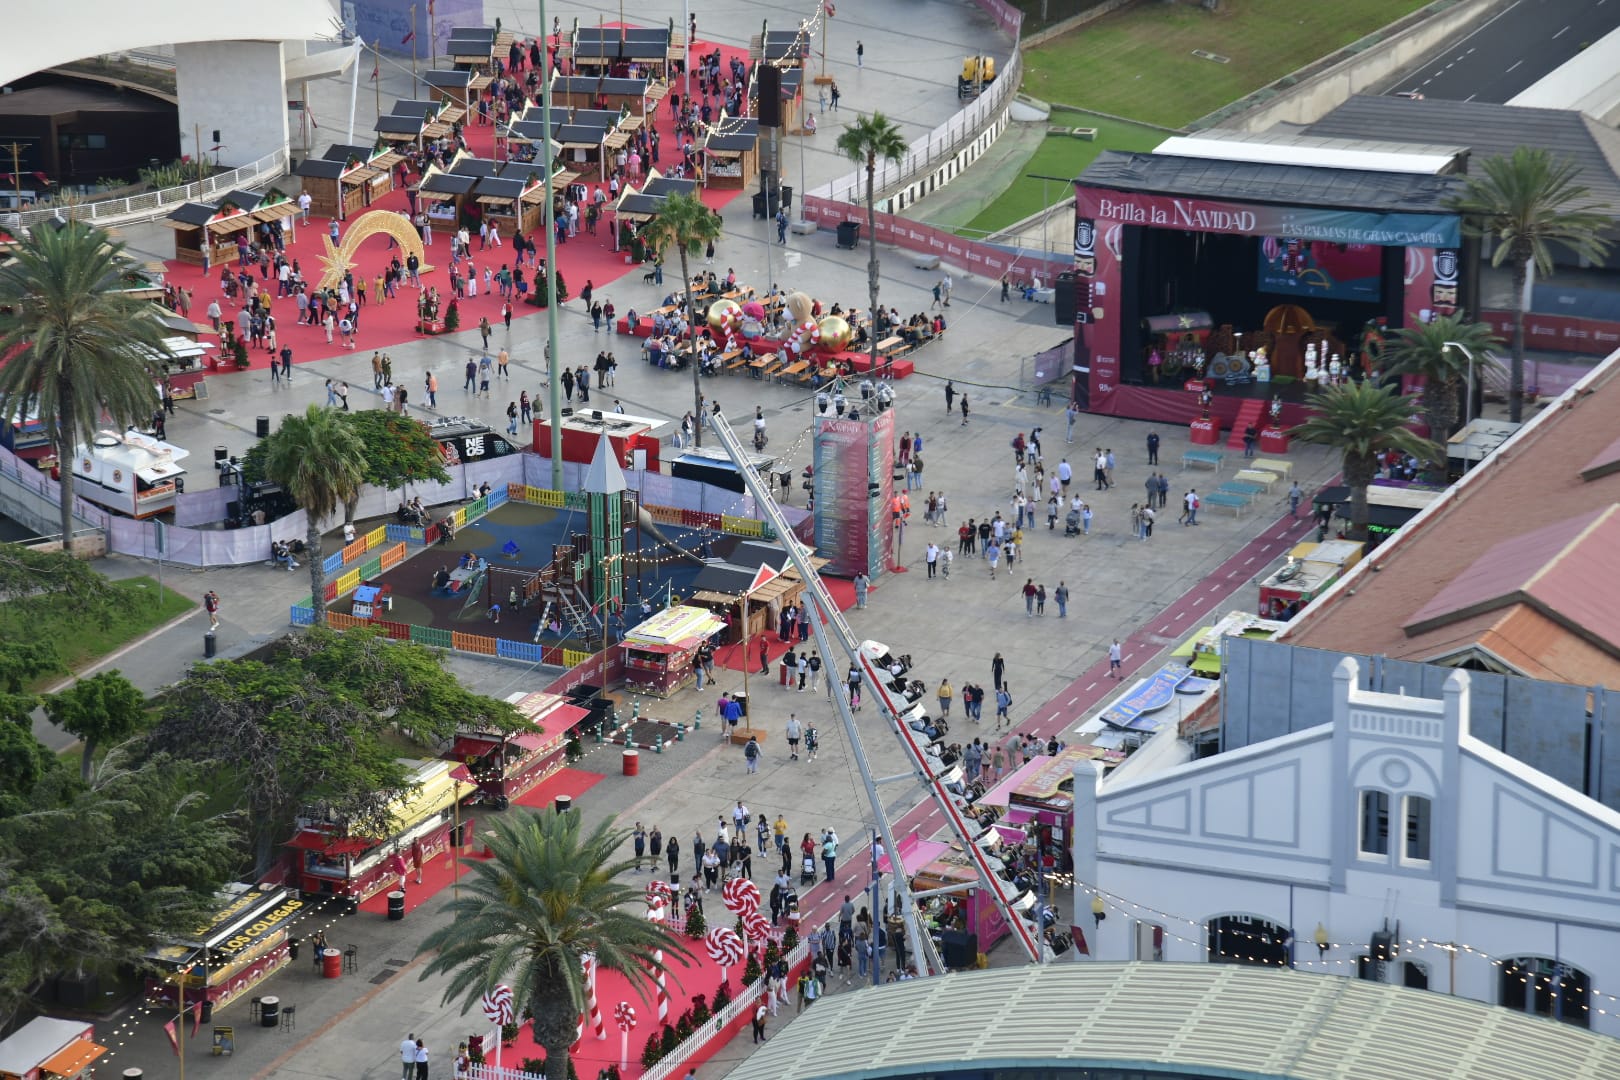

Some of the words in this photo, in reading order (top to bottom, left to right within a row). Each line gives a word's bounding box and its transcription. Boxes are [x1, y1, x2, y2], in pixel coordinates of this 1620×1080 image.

[1099, 199, 1146, 223] Brilla
[1151, 205, 1168, 224] la
[1173, 200, 1256, 231] NAVIDAD
[1282, 223, 1302, 236] LAS
[1302, 225, 1346, 240] PALMAS
[1347, 229, 1361, 241] DE
[1363, 230, 1395, 242] GRAN
[1395, 231, 1444, 244] CANARIA
[212, 891, 262, 922] COLEGAS
[220, 934, 251, 952] LOS
[244, 899, 303, 937] COLEGAS
